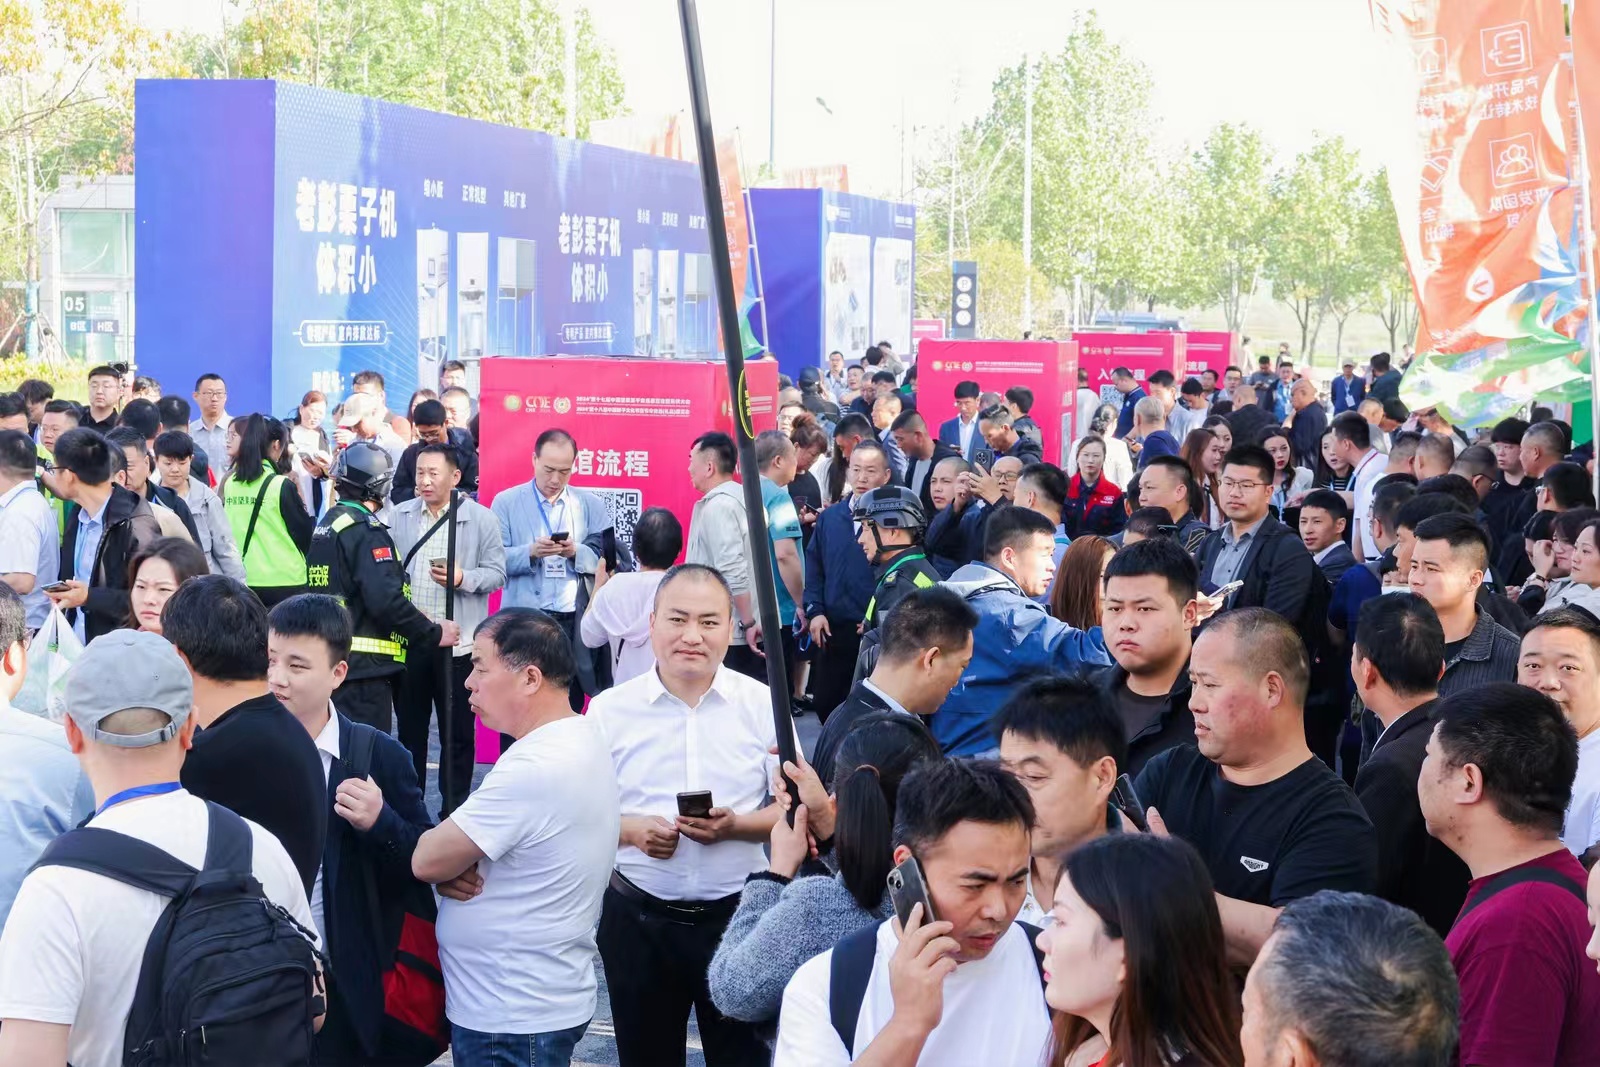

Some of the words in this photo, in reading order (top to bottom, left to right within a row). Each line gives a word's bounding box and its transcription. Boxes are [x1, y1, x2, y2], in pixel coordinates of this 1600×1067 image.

[316, 241, 377, 294] 体积小
[571, 262, 608, 303] 体积小
[65, 297, 84, 311] 05
[97, 321, 114, 332] H区
